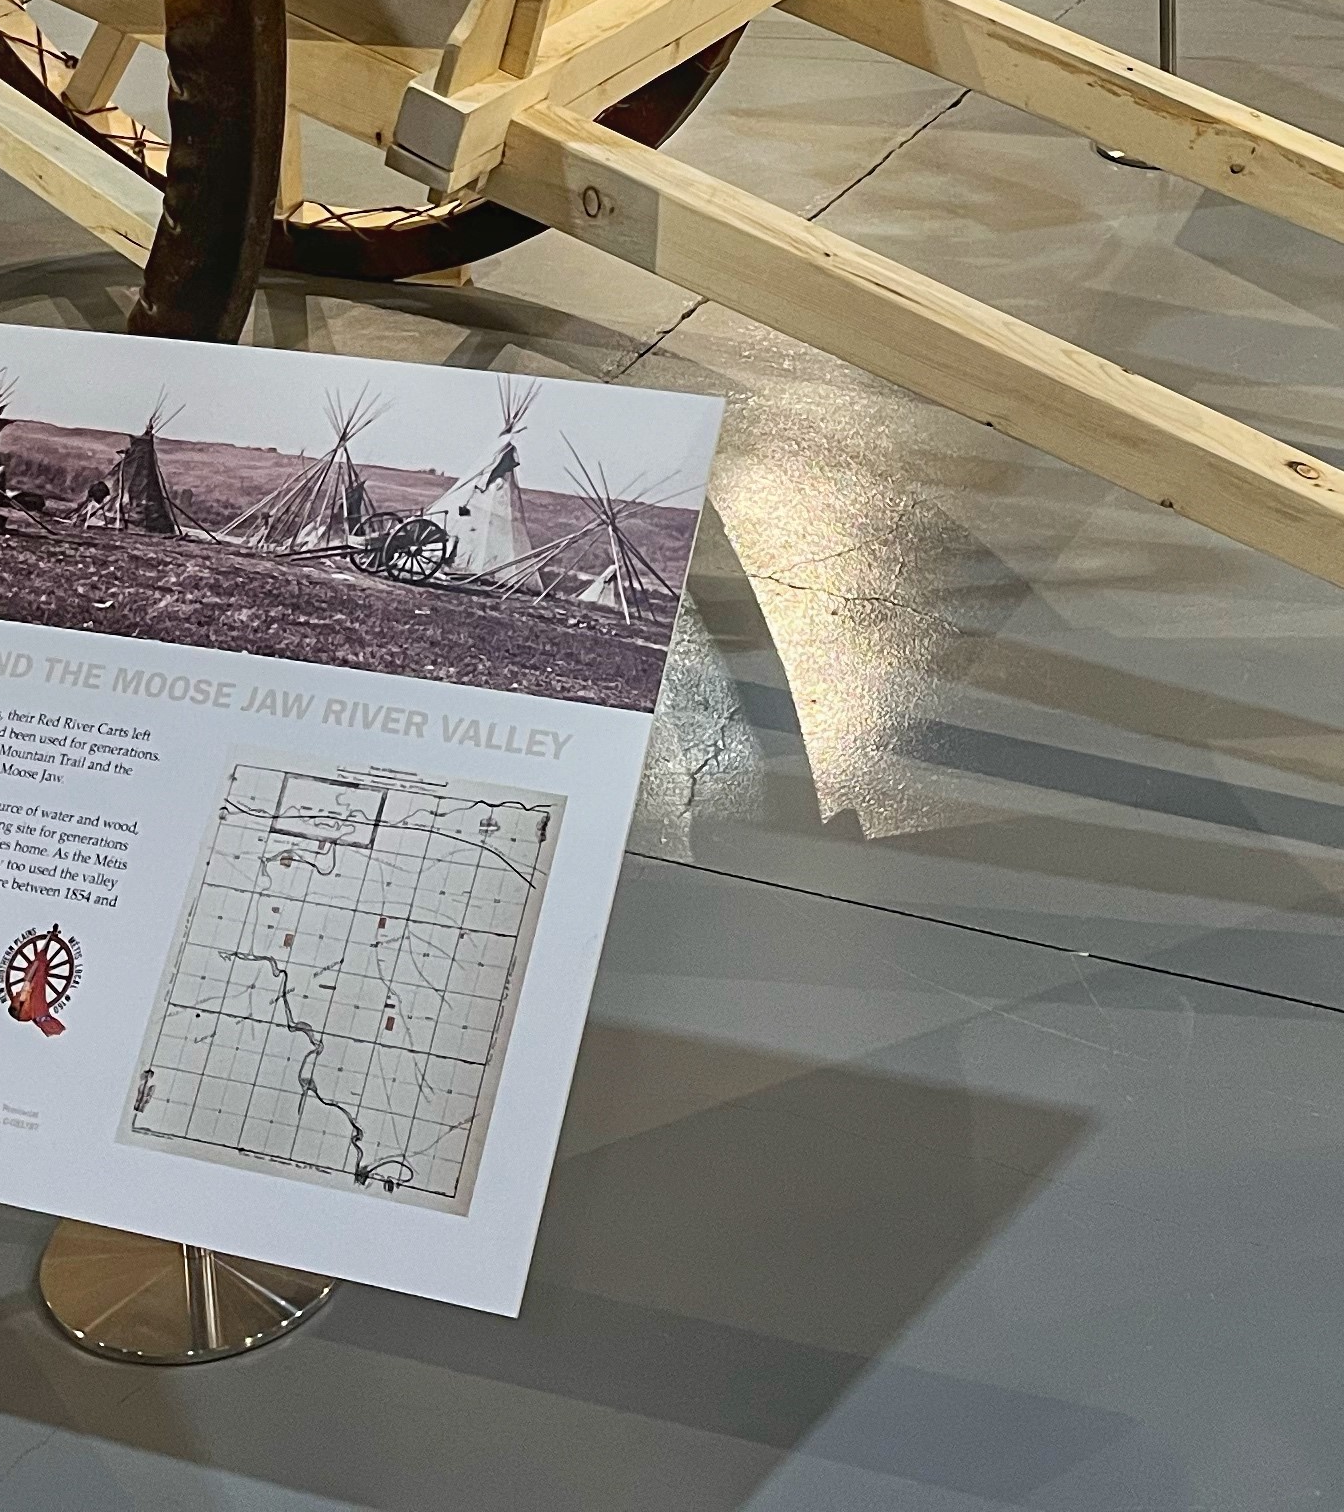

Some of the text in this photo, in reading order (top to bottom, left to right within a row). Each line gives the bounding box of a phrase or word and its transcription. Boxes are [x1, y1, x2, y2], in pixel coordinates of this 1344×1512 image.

[45, 656, 105, 689] THE
[113, 667, 236, 708] MOOSE
[241, 686, 314, 719] JAW
[322, 698, 428, 738] RIVER
[443, 714, 573, 759] VALLEY
[7, 709, 36, 723] their
[37, 713, 62, 727] Red
[63, 717, 96, 732] River
[97, 722, 129, 737] Carts
[131, 727, 151, 741] left
[8, 727, 37, 742] been
[39, 735, 68, 747] used
[69, 736, 88, 749] for
[88, 743, 161, 761] generations.
[0, 762, 39, 779] Moose
[59, 753, 87, 767] Trail
[87, 760, 112, 771] and
[113, 762, 134, 775] the
[25, 805, 41, 816] of
[41, 809, 75, 822] water
[76, 815, 101, 827] and
[103, 819, 139, 835] wood,
[15, 822, 37, 835] site
[38, 825, 58, 838] for
[57, 831, 129, 851] generations
[51, 847, 70, 859] As
[71, 849, 92, 863] the
[6, 859, 26, 871] too
[28, 864, 58, 877] used
[59, 867, 80, 881] the
[82, 872, 119, 891] valley
[11, 876, 61, 897] between
[64, 887, 92, 902] 1854
[93, 894, 119, 907] and
